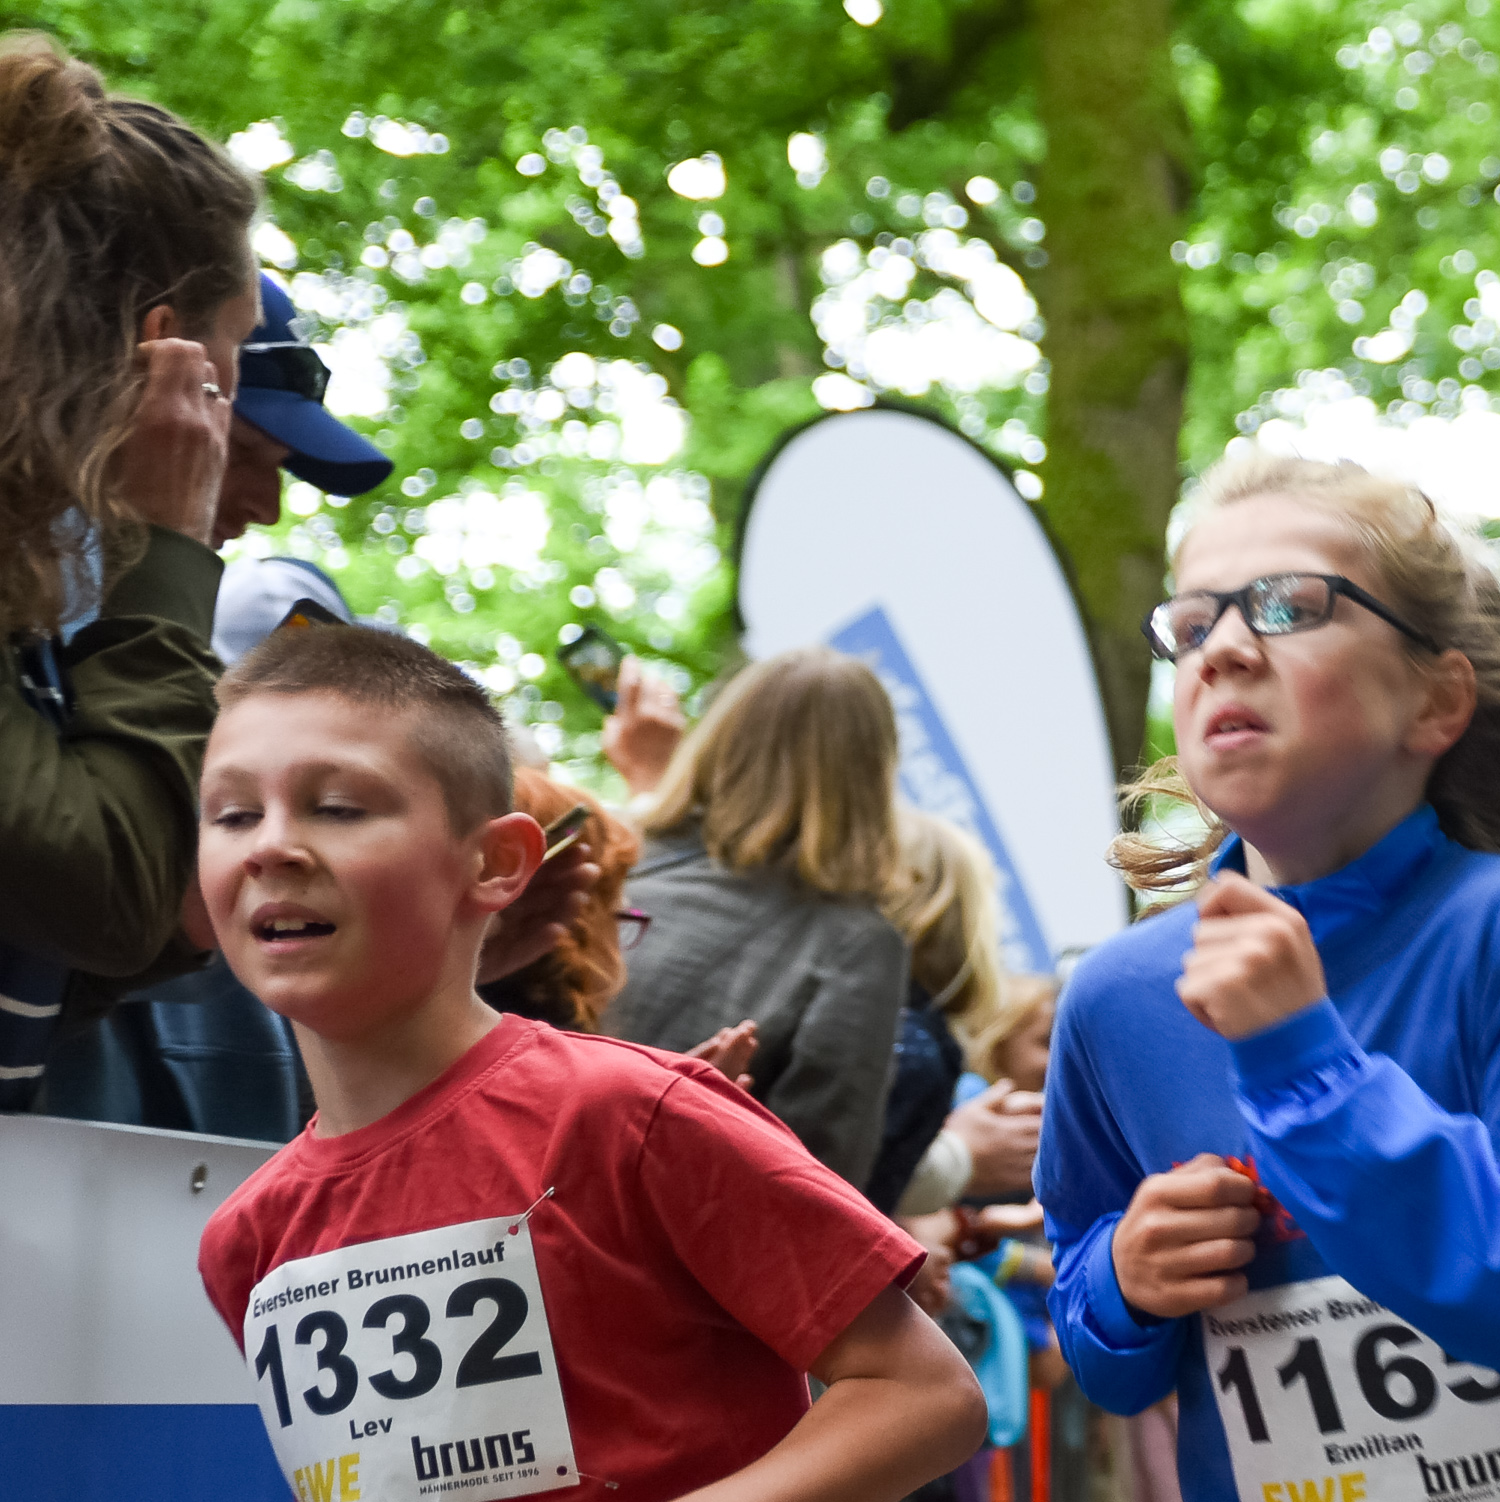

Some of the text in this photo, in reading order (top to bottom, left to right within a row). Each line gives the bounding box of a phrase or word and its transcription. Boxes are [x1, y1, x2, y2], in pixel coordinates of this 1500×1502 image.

[252, 1241, 505, 1318] Everstener Brunnenlauf
[254, 1278, 543, 1429] 1332
[349, 1417, 393, 1440] Lev
[1323, 1432, 1424, 1465] Emilian
[410, 1429, 536, 1481] bruns
[492, 1471, 515, 1483] SEIT
